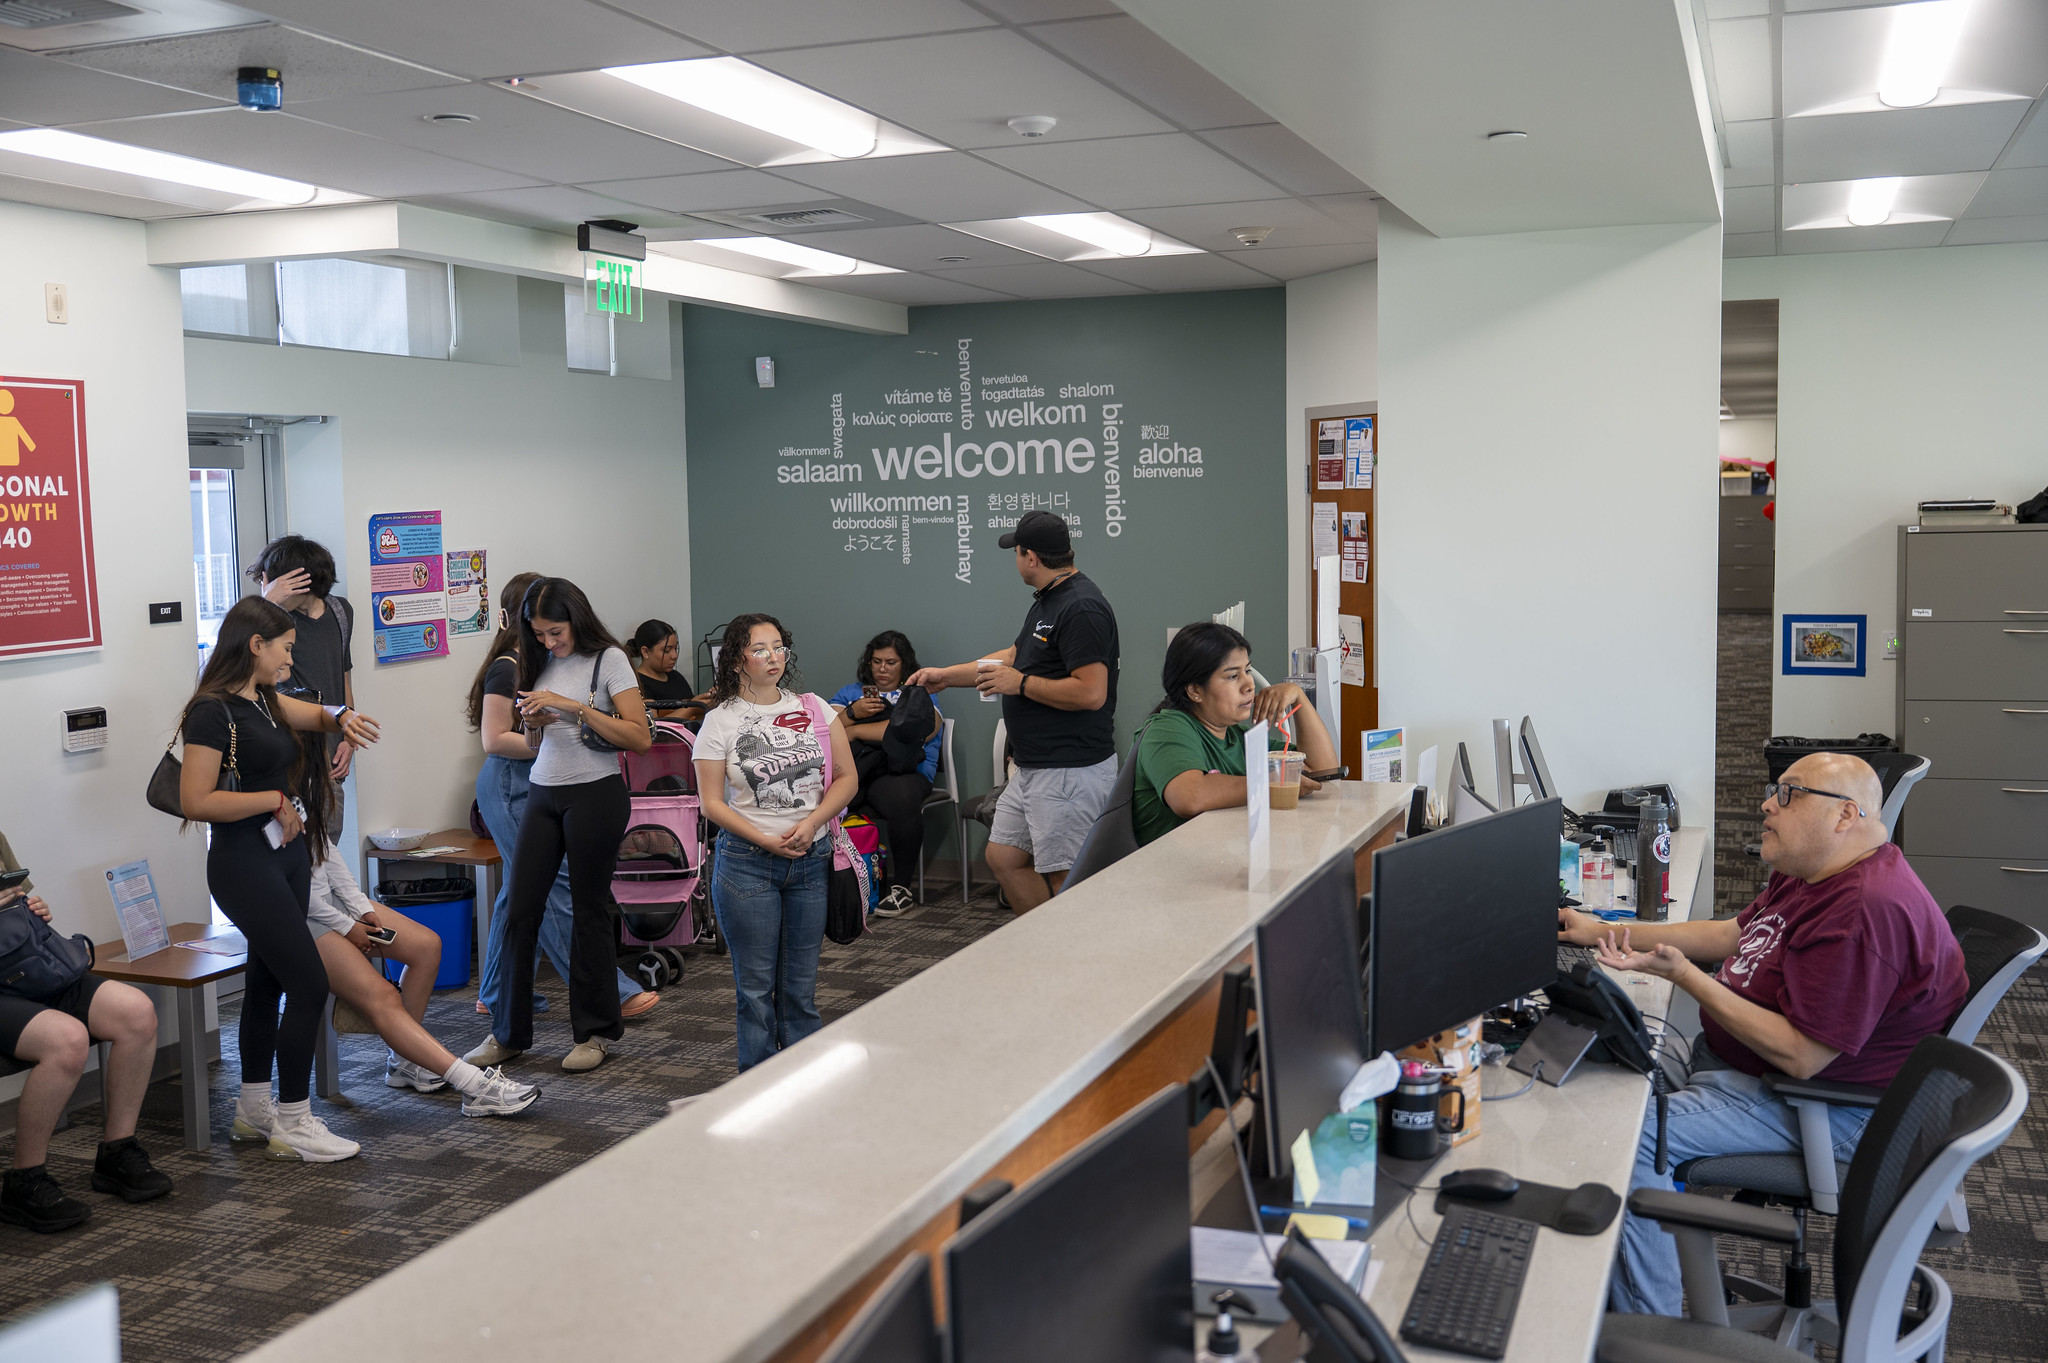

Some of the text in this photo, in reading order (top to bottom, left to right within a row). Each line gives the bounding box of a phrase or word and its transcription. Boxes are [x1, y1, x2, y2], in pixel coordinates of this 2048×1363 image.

[596, 259, 633, 315] EXIT
[958, 338, 975, 430] benvenuto
[981, 374, 1028, 385] tervetuloa
[884, 389, 934, 404] vítáme
[981, 385, 1045, 402] fogadtatás
[1059, 382, 1114, 399] shalom
[852, 410, 953, 427] καλώς ορίσατε
[985, 401, 1086, 428] welkom
[830, 393, 845, 459] swagata
[1141, 424, 1169, 440] 歡迎
[778, 446, 830, 457] välkommen
[871, 432, 1095, 481] welcome
[1138, 442, 1203, 465] aloha
[777, 459, 862, 484] salaam
[1102, 403, 1126, 538] bienvenido
[1133, 465, 1203, 478] bienvenue
[830, 492, 952, 513] willkommen
[987, 491, 1070, 511] 환영합니다
[832, 516, 898, 529] dobrodošli
[0, 527, 32, 548] 40
[844, 534, 897, 552] ようこそ
[902, 514, 912, 565] namaste
[955, 495, 974, 584] mabuhay
[160, 607, 172, 615] EXIT
[774, 733, 786, 741] AND
[752, 750, 824, 784] SUPERMA
